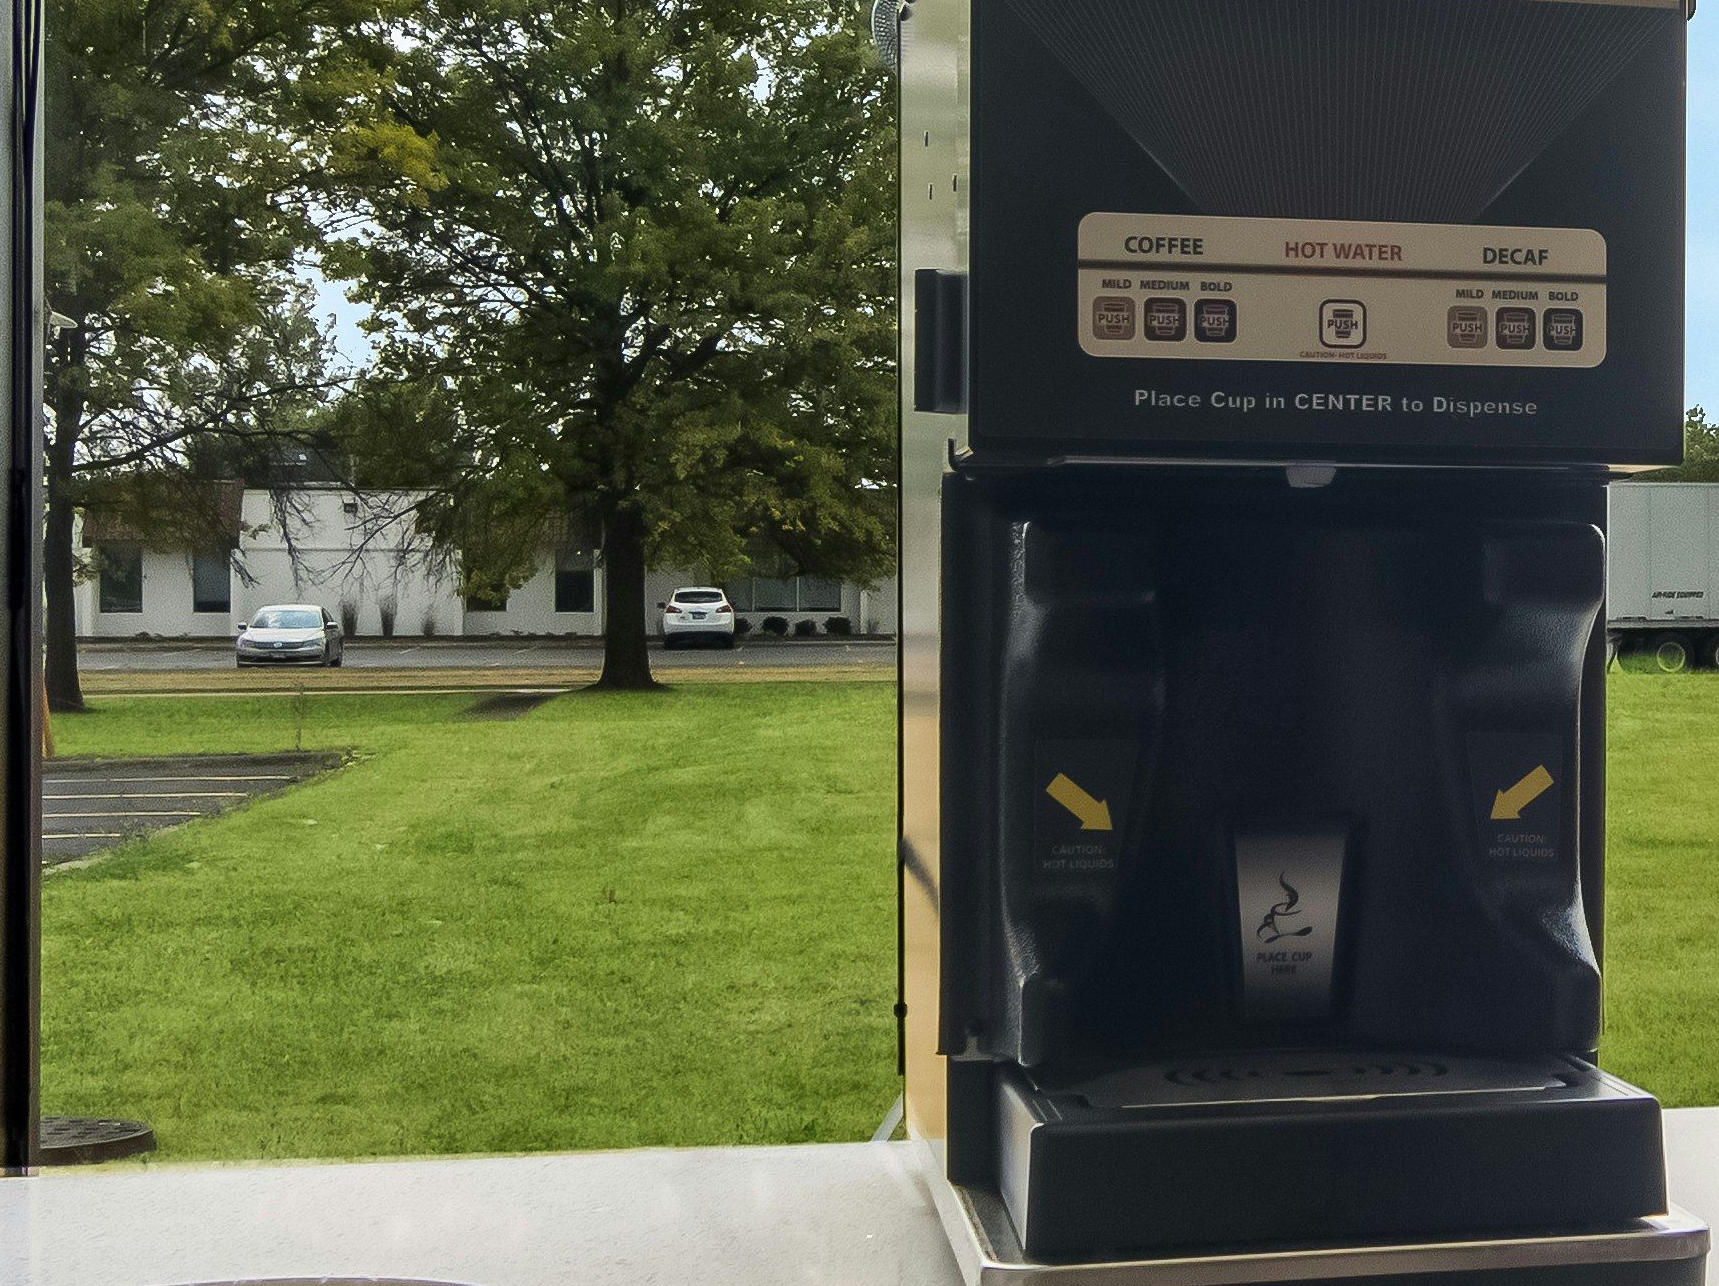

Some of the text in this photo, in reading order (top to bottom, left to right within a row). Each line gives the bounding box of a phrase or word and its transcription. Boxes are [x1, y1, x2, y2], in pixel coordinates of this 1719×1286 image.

[1123, 235, 1549, 266] COFFEE HOT WATER DECAF
[1101, 278, 1233, 292] MILD MEDIUM BOLD
[1455, 289, 1579, 302] MILD MEDIUM BOLD
[1097, 313, 1131, 325] PUSH
[1149, 314, 1180, 326] PUSH
[1200, 315, 1230, 327] PUSH
[1327, 319, 1359, 330] PUSH
[1452, 322, 1483, 333] PUSH
[1500, 323, 1530, 334] PUSH
[1548, 324, 1578, 336] PUSH
[1134, 389, 1538, 418] Place Cup in CENTER to Dispense
[1487, 846, 1555, 859] HOT LIQUIDS
[1042, 858, 1115, 870] HOT LIQUIDS
[1256, 951, 1313, 963] PLACE CUP
[1270, 964, 1298, 975] HERE
